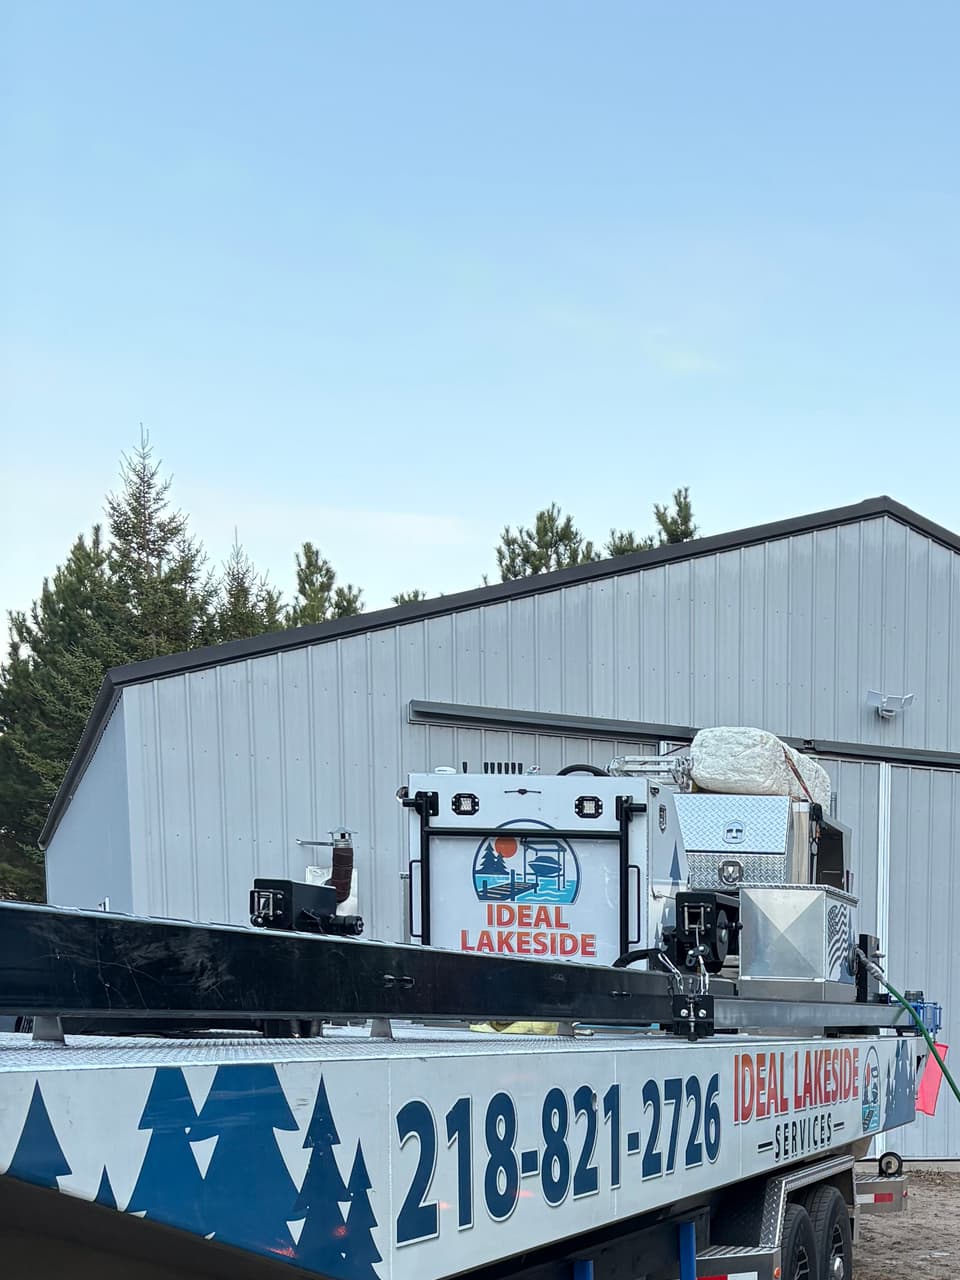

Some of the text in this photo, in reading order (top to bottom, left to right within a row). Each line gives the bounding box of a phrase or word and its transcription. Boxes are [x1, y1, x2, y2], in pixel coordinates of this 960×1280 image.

[486, 903, 570, 930] IDEAL
[460, 929, 597, 957] LAKESIDE
[733, 1047, 860, 1124] IDEAL LAKESIDE
[395, 1072, 722, 1248] 218-821-2726
[774, 1112, 833, 1162] SERVICES
